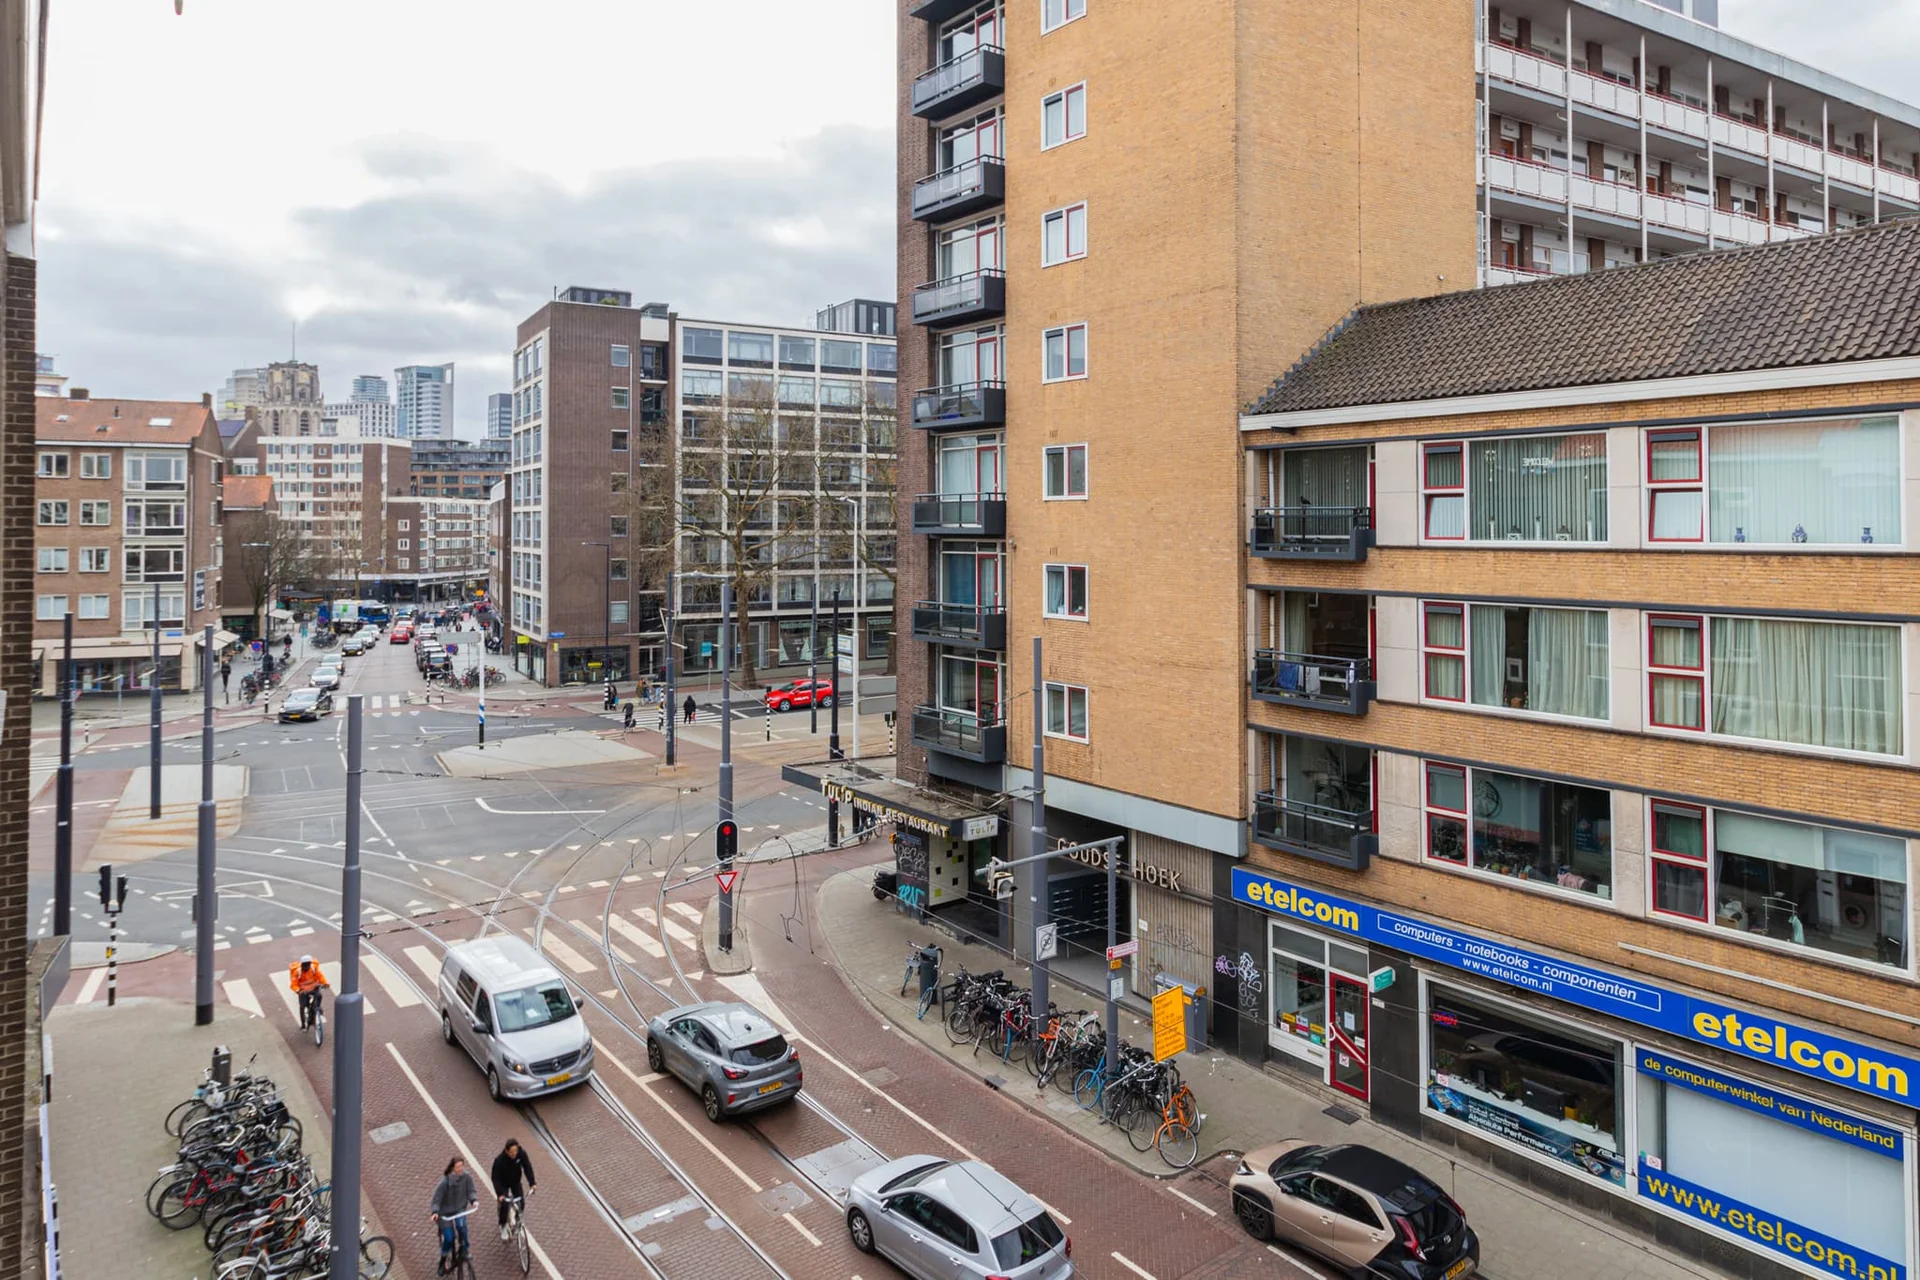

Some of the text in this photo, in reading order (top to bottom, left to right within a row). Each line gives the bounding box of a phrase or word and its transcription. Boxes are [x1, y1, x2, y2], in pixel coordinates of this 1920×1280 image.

[853, 796, 886, 817] INDIAN
[885, 807, 948, 839] RESTAURANT
[1132, 861, 1182, 892] HOEK
[1246, 881, 1359, 931] etelcom
[1394, 922, 1453, 948] computers
[1464, 941, 1530, 970] notebooks
[1542, 964, 1637, 1001] componenten
[1462, 957, 1553, 992] www.etelcom.nl
[1692, 1012, 1908, 1097] etelcom
[1468, 1104, 1488, 1118] Total
[1489, 1112, 1520, 1131] Control
[1644, 1057, 1895, 1149] de computerwinkel van Nederland
[1468, 1113, 1503, 1132] Absolute
[1504, 1126, 1558, 1154] Performance
[1646, 1174, 1898, 1280] www.etelcom.nl
